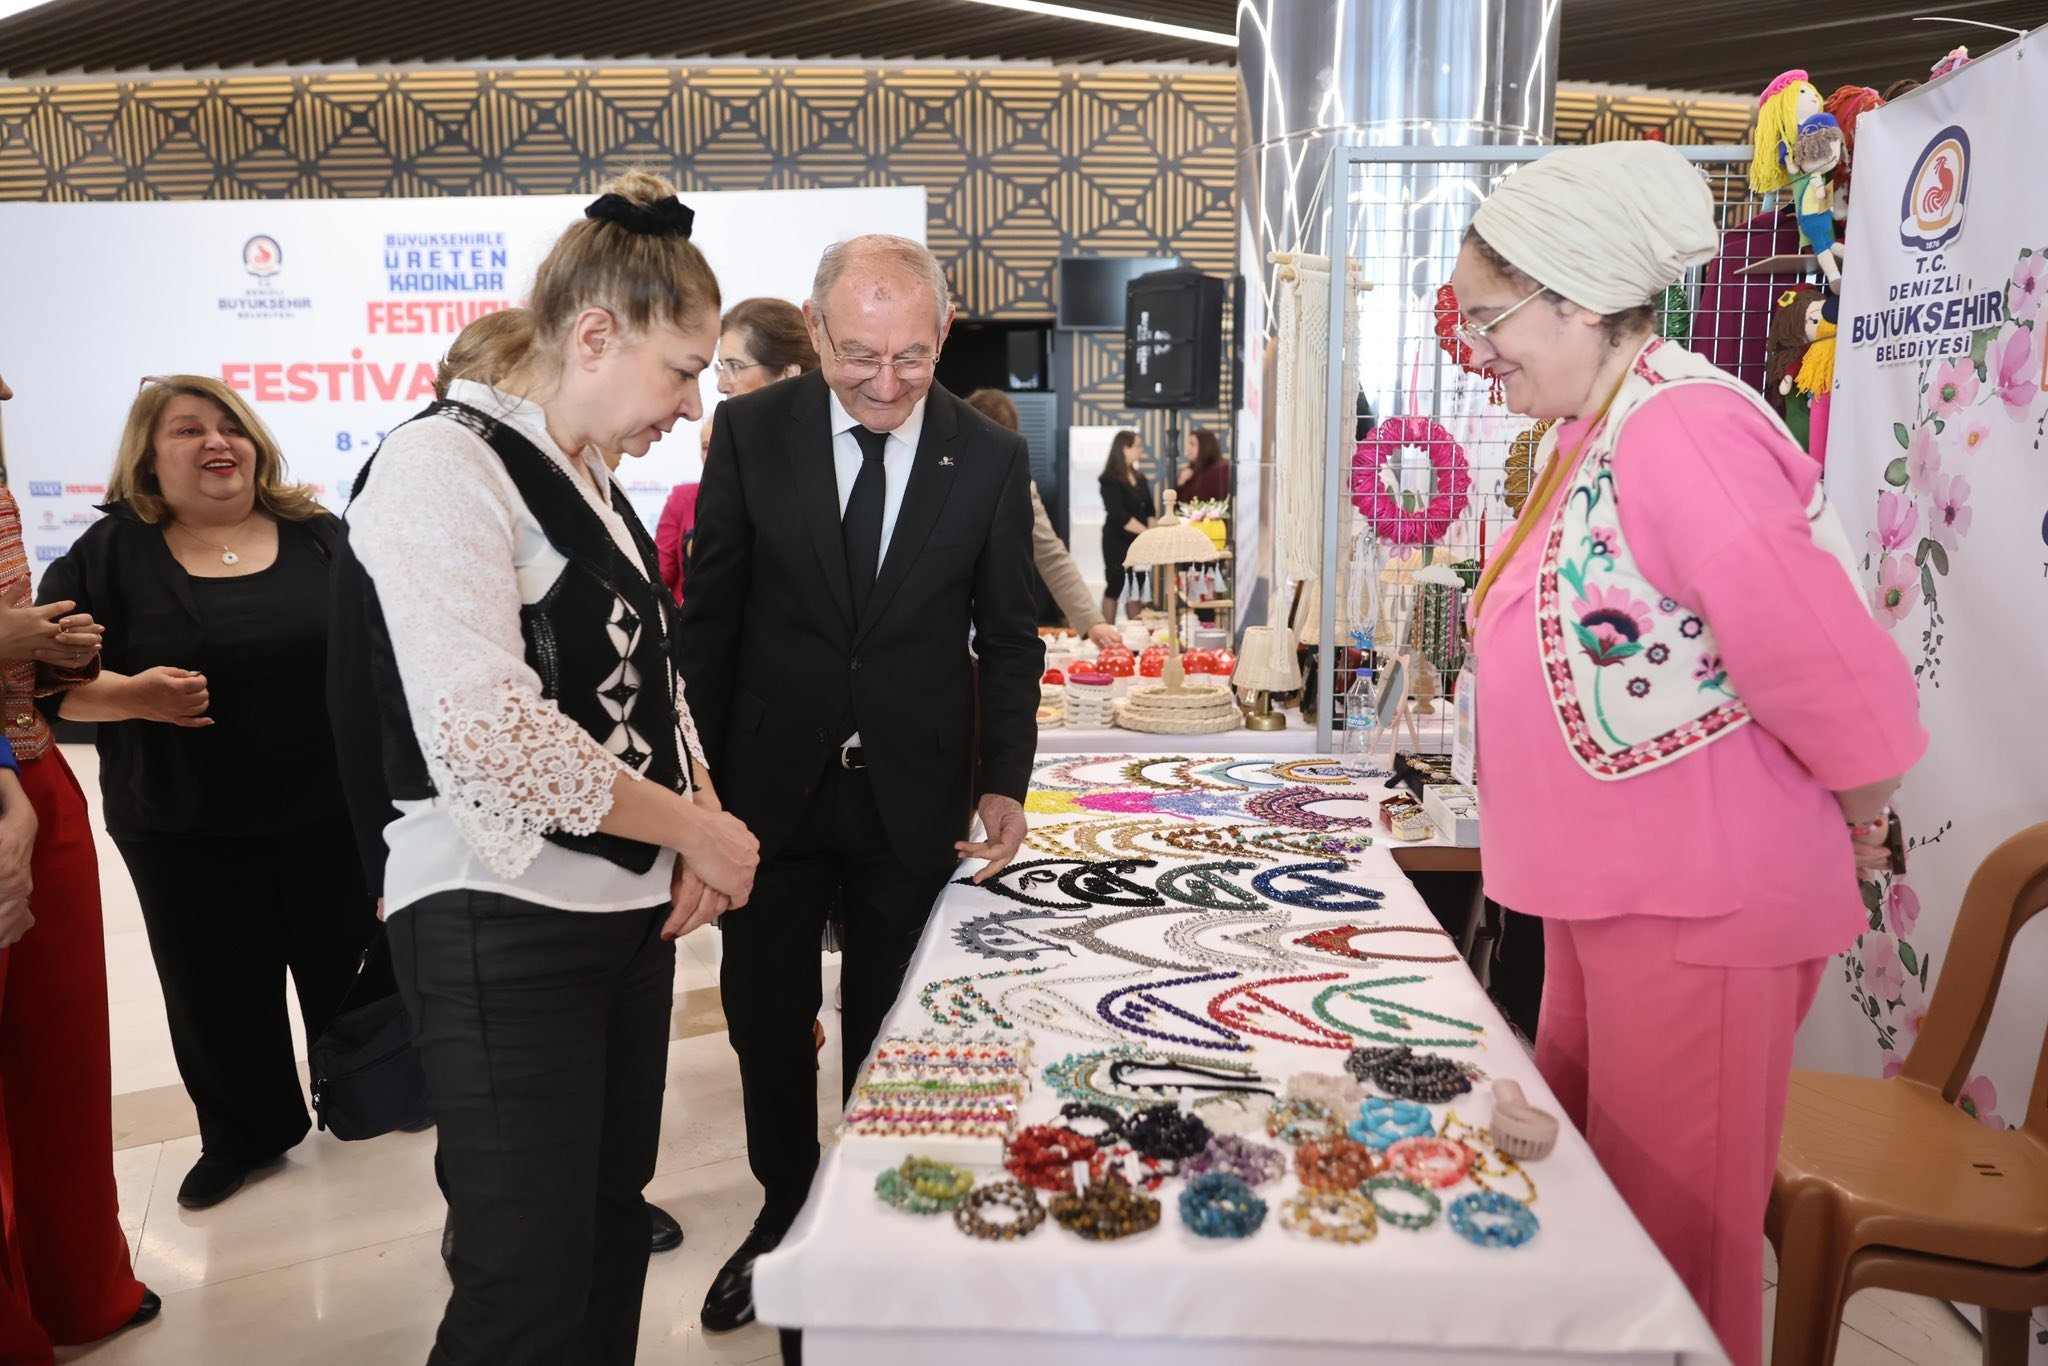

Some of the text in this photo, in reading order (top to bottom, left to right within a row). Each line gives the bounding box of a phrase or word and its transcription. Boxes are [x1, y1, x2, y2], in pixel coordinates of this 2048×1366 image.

[1916, 254, 1946, 274] T.C.
[390, 273, 503, 291] KADINLAR
[1890, 274, 1961, 301] DENİZLİ
[1852, 290, 2002, 343] BÜYÜKŞEHİR
[1876, 336, 1970, 362] BELEDİYESİ
[336, 432, 351, 451] 8
